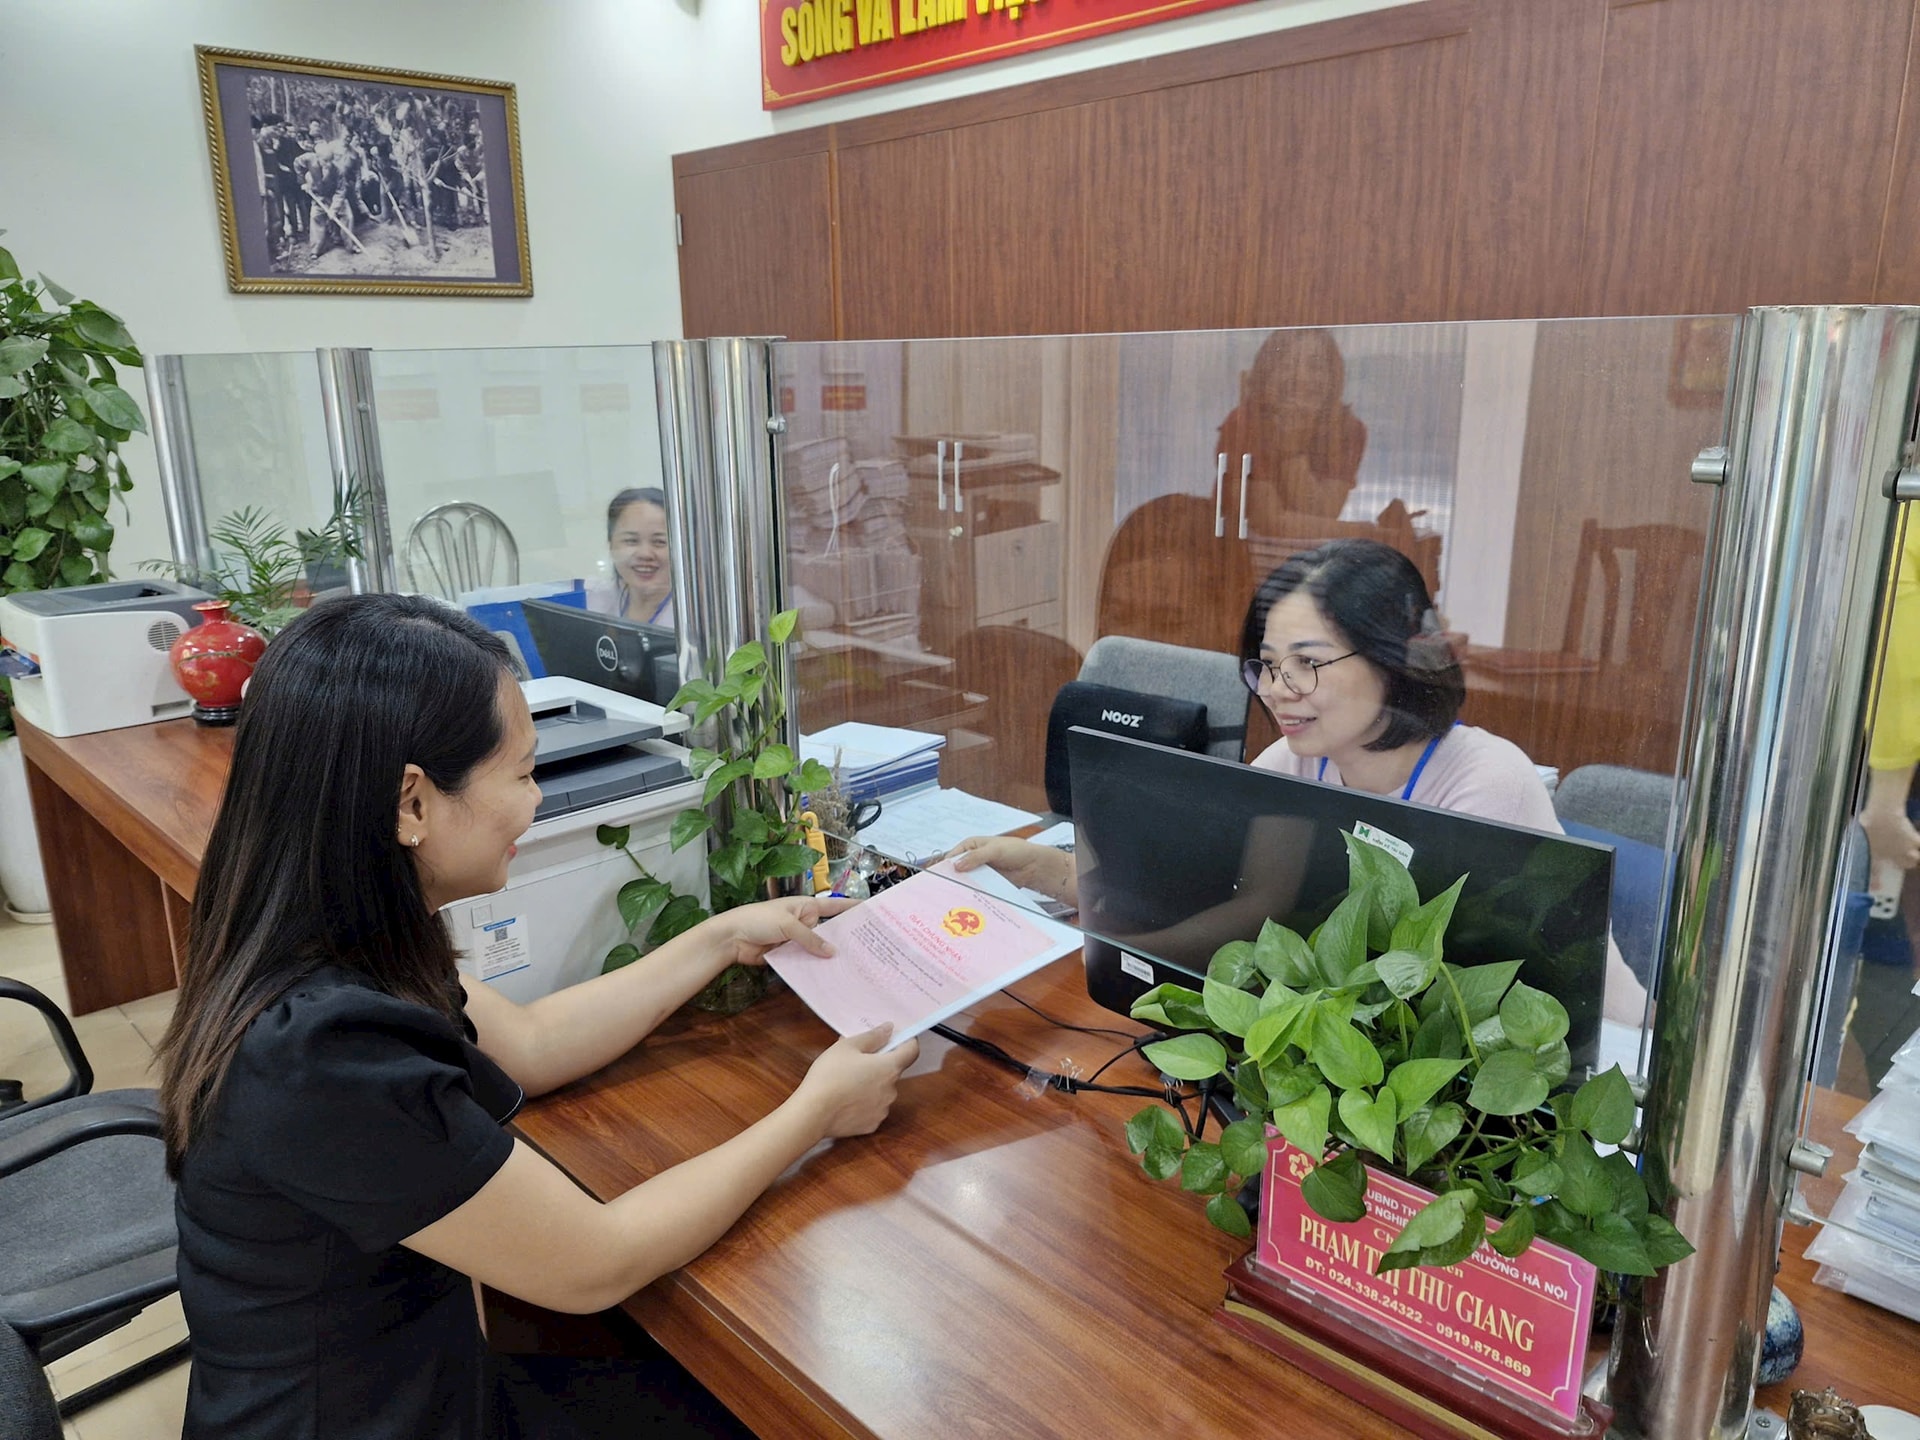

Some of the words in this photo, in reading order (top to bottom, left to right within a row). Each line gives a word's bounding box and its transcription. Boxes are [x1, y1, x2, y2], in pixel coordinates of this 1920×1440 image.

[599, 647, 616, 661] DELL
[1101, 709, 1140, 728] NOOZ
[1367, 1188, 1400, 1210] UBND
[1299, 1213, 1361, 1270] PHẠM
[1407, 1266, 1453, 1313] THU
[1455, 1290, 1535, 1352] GIANG
[1471, 1250, 1520, 1279] RƯỜNG
[1522, 1272, 1541, 1289] HÀ
[1544, 1281, 1569, 1301] NỘI
[1305, 1256, 1326, 1275] ĐT:
[1328, 1268, 1423, 1324] 024.338.24322
[1436, 1322, 1532, 1378] 0919.878.869
